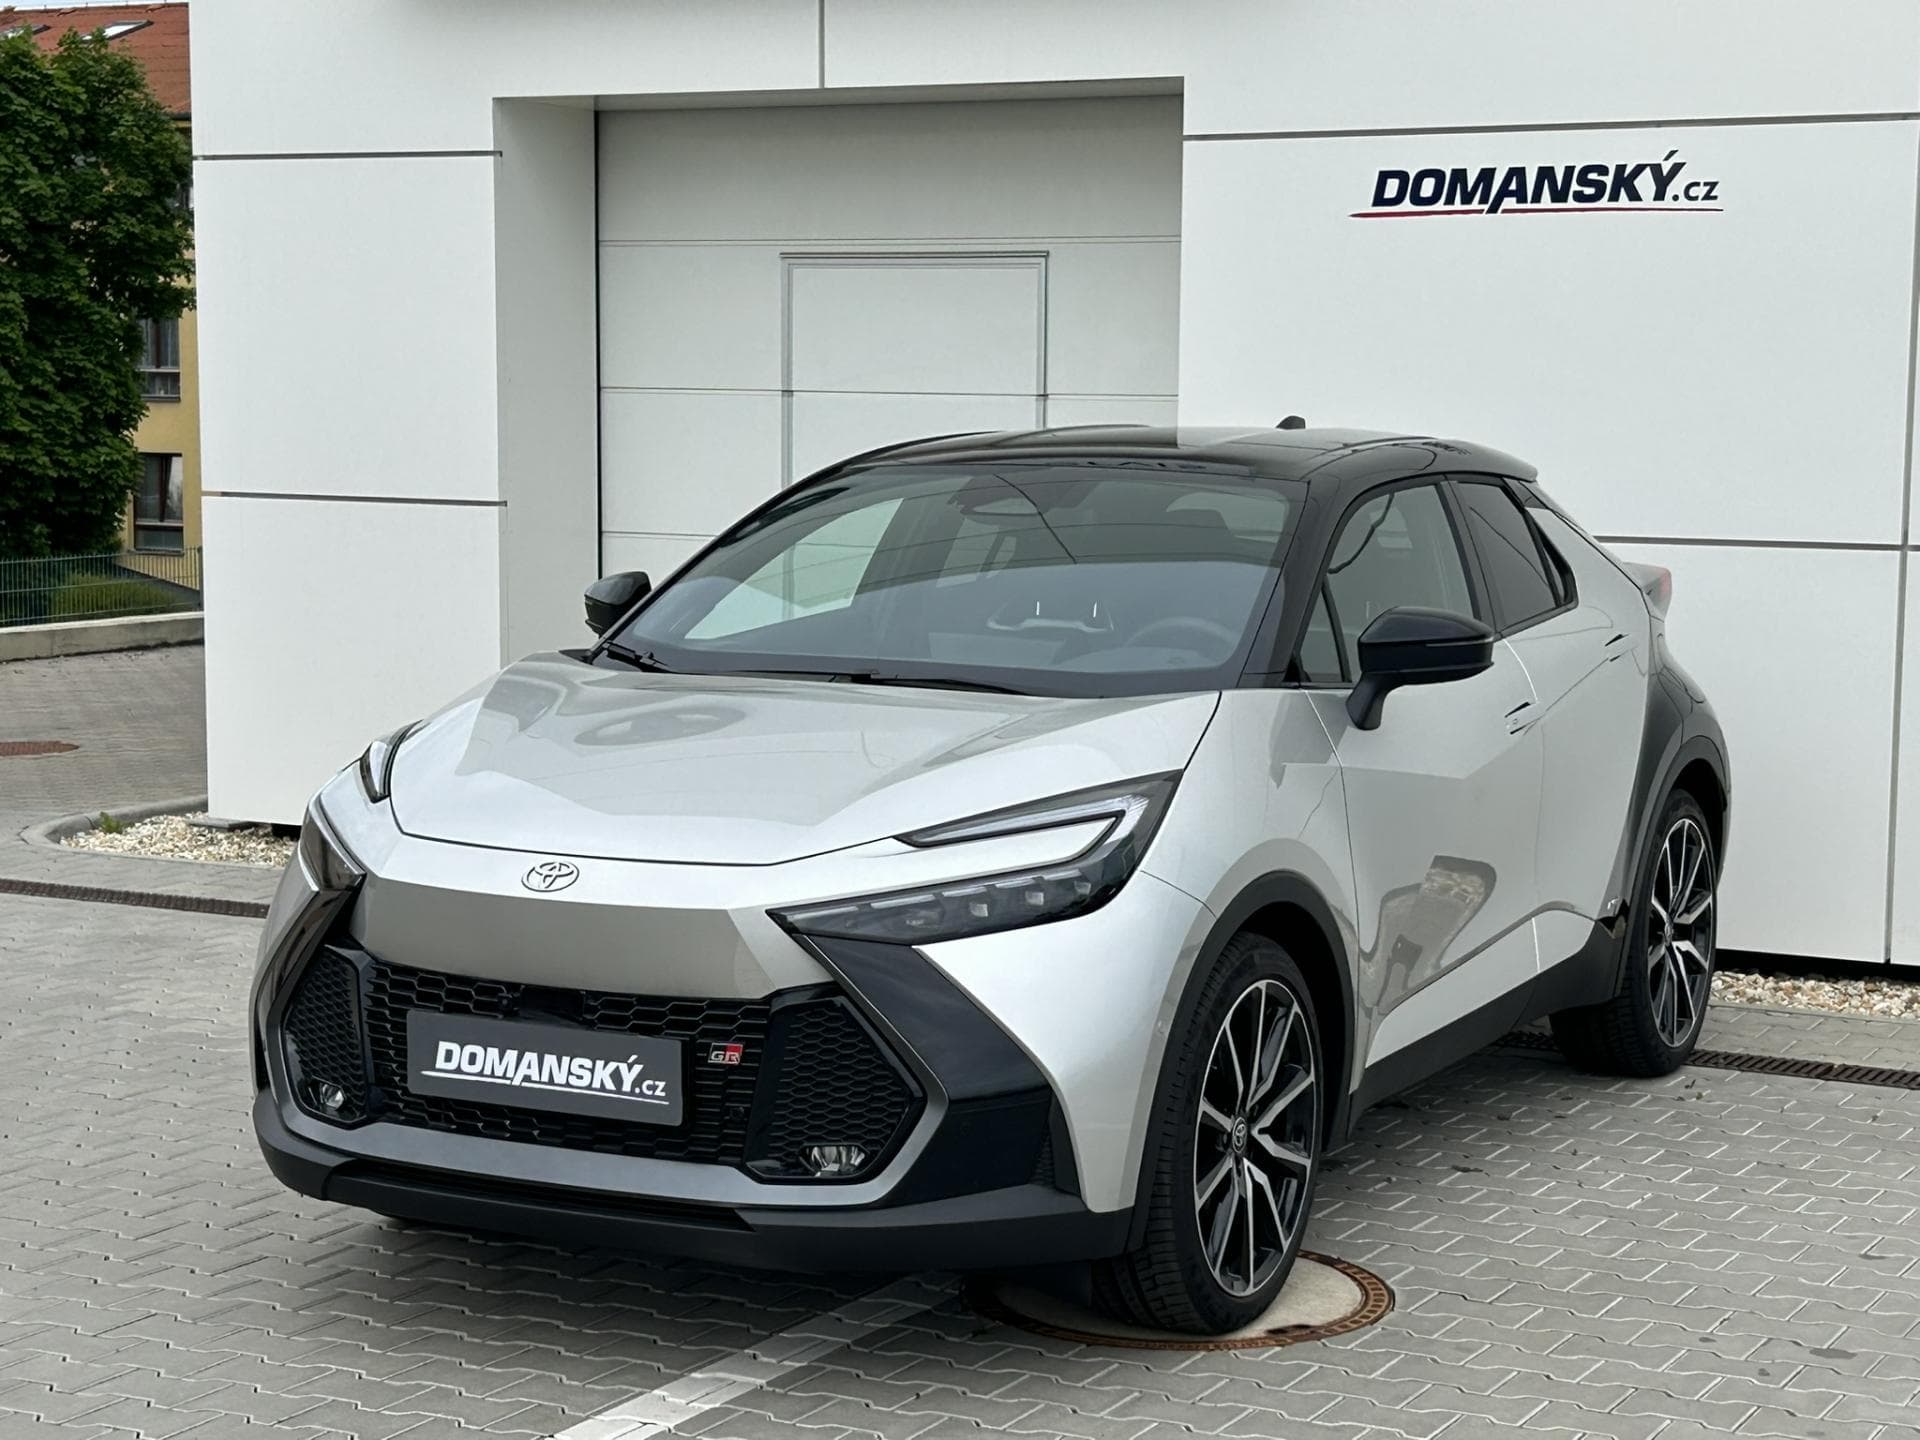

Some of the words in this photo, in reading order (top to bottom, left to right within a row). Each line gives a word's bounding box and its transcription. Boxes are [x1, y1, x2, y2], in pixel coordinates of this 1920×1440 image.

[1372, 150, 1719, 214] DOMANSKÝ.cz
[435, 1041, 666, 1096] DOMANSKÝ.cz
[710, 1050, 741, 1065] GR
